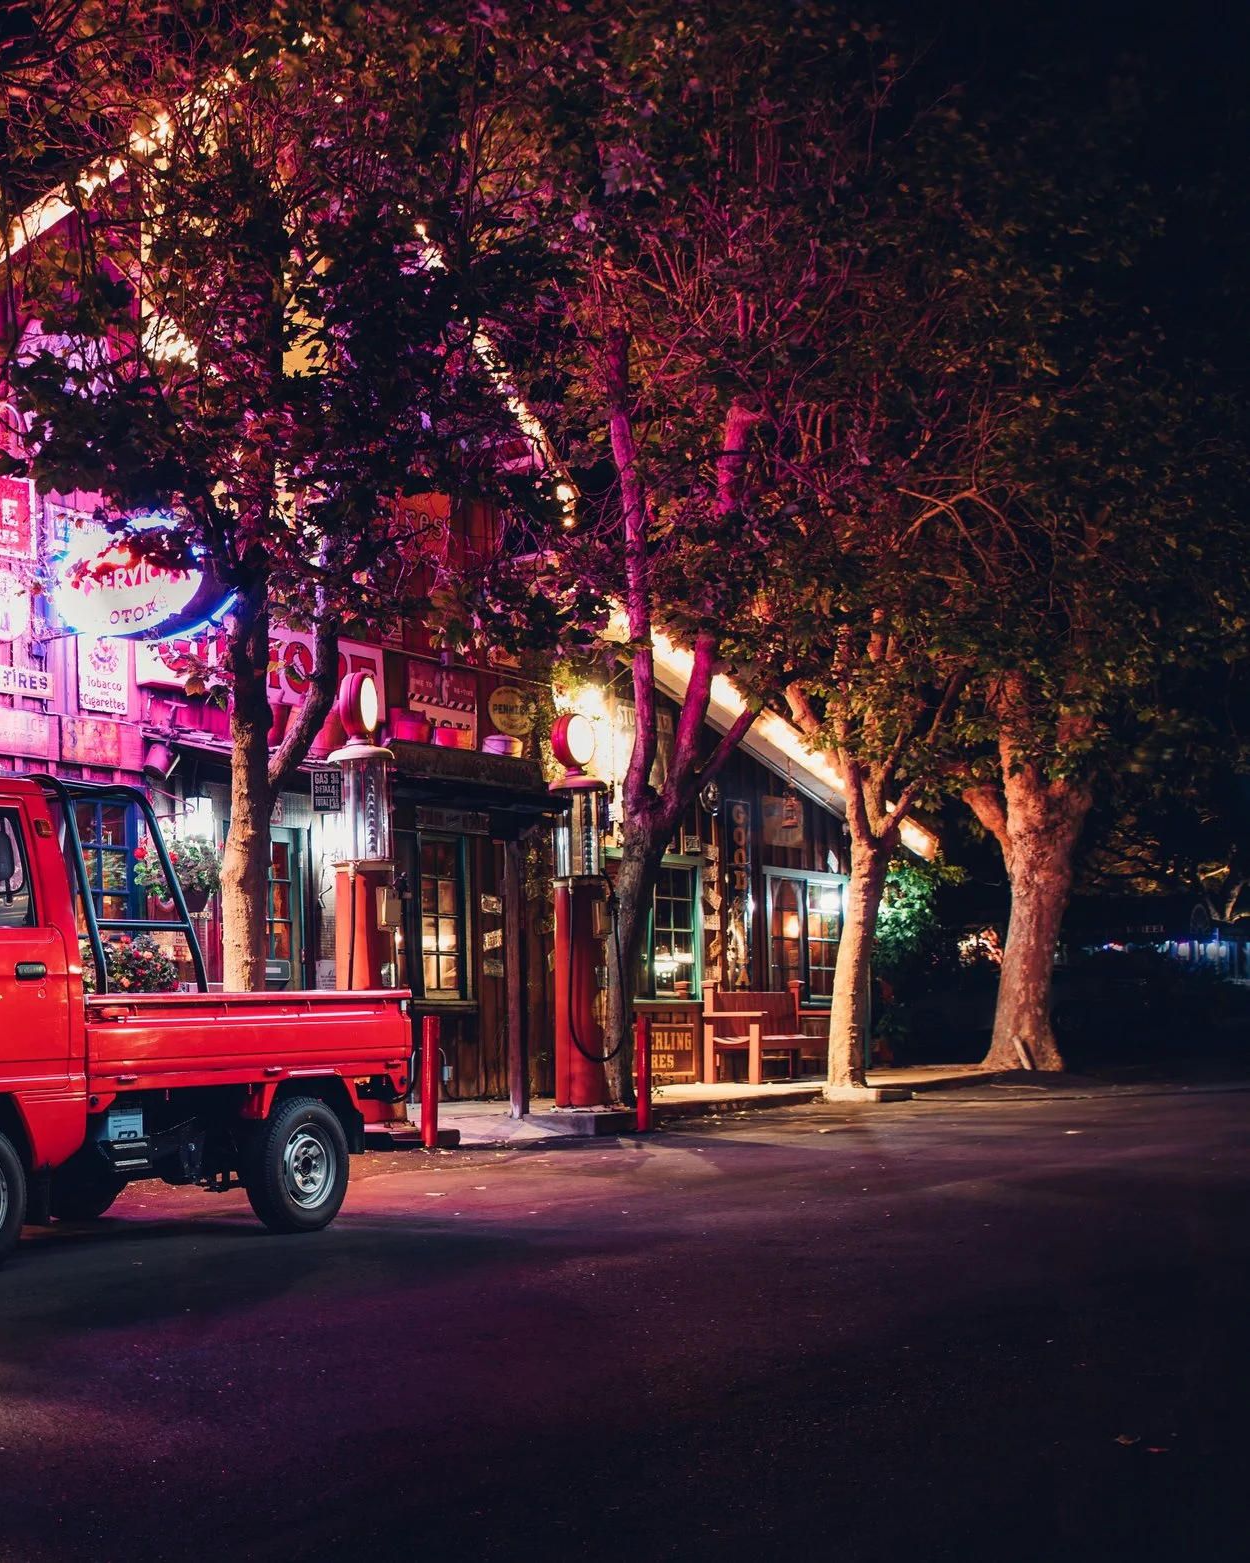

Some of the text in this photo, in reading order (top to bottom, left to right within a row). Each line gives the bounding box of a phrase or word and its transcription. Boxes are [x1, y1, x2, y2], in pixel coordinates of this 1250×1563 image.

[4, 669, 48, 690] TIRES
[86, 675, 122, 691] Tobacco
[84, 693, 126, 711] Cigarettes
[315, 773, 329, 784] GAS
[635, 1032, 692, 1051] ERLING
[651, 1054, 675, 1069] RES
